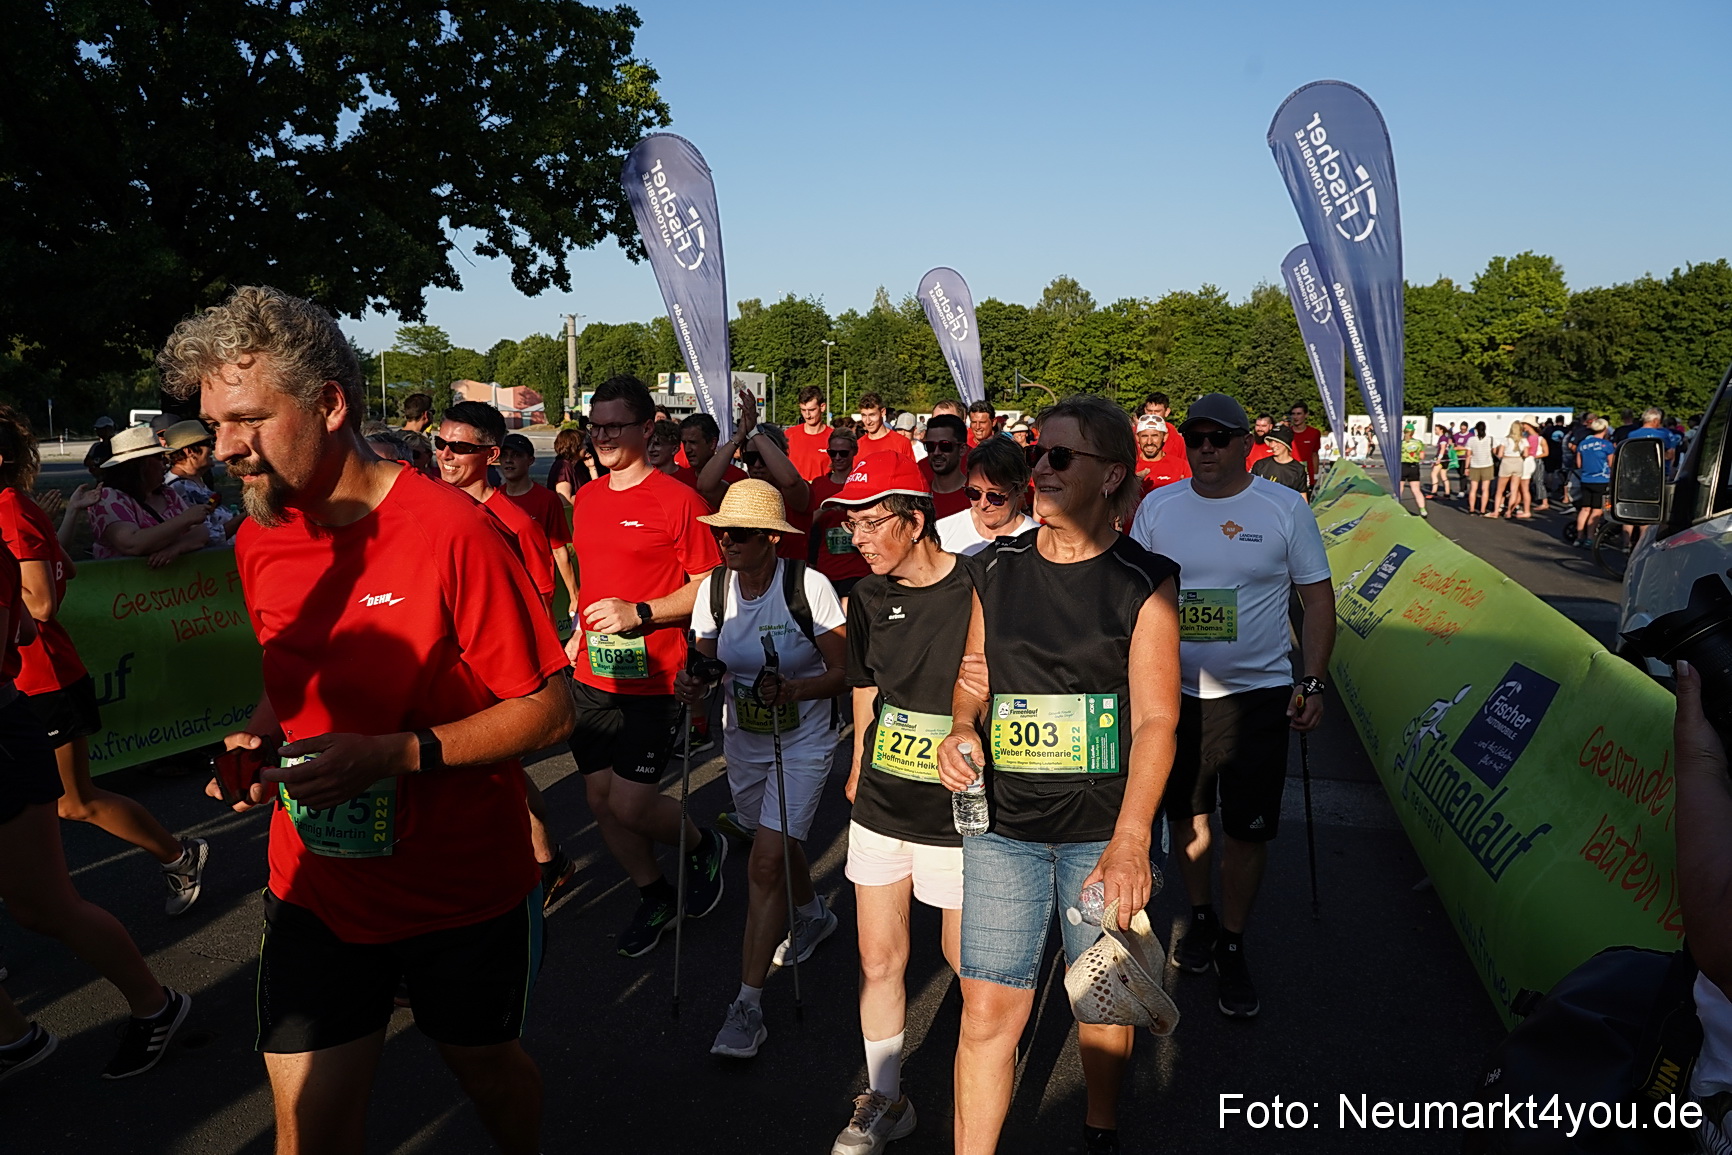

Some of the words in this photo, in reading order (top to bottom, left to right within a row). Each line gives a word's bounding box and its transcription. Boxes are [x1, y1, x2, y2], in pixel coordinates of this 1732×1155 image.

[112, 572, 219, 620] Gesunde
[1180, 606, 1226, 624] 1354
[1226, 609, 1234, 634] 2022
[596, 647, 636, 665] 1683
[635, 649, 645, 672] 2022
[1489, 695, 1532, 730] Fischer
[1009, 721, 1059, 748] 303
[1485, 716, 1519, 741] AUTOMOBILE
[876, 730, 886, 761] WALK
[890, 731, 933, 759] 272
[1000, 748, 1023, 757] Weber
[1025, 749, 1072, 758] Rosemarie
[1071, 726, 1081, 762] 2022
[634, 765, 656, 773] JAKO
[882, 752, 915, 767] Hoffmann
[1580, 725, 1674, 817] Gesunde
[373, 796, 389, 843] 2022
[1411, 733, 1553, 882] firmenlauf
[325, 826, 367, 839] Martin
[1580, 814, 1661, 911] laufen
